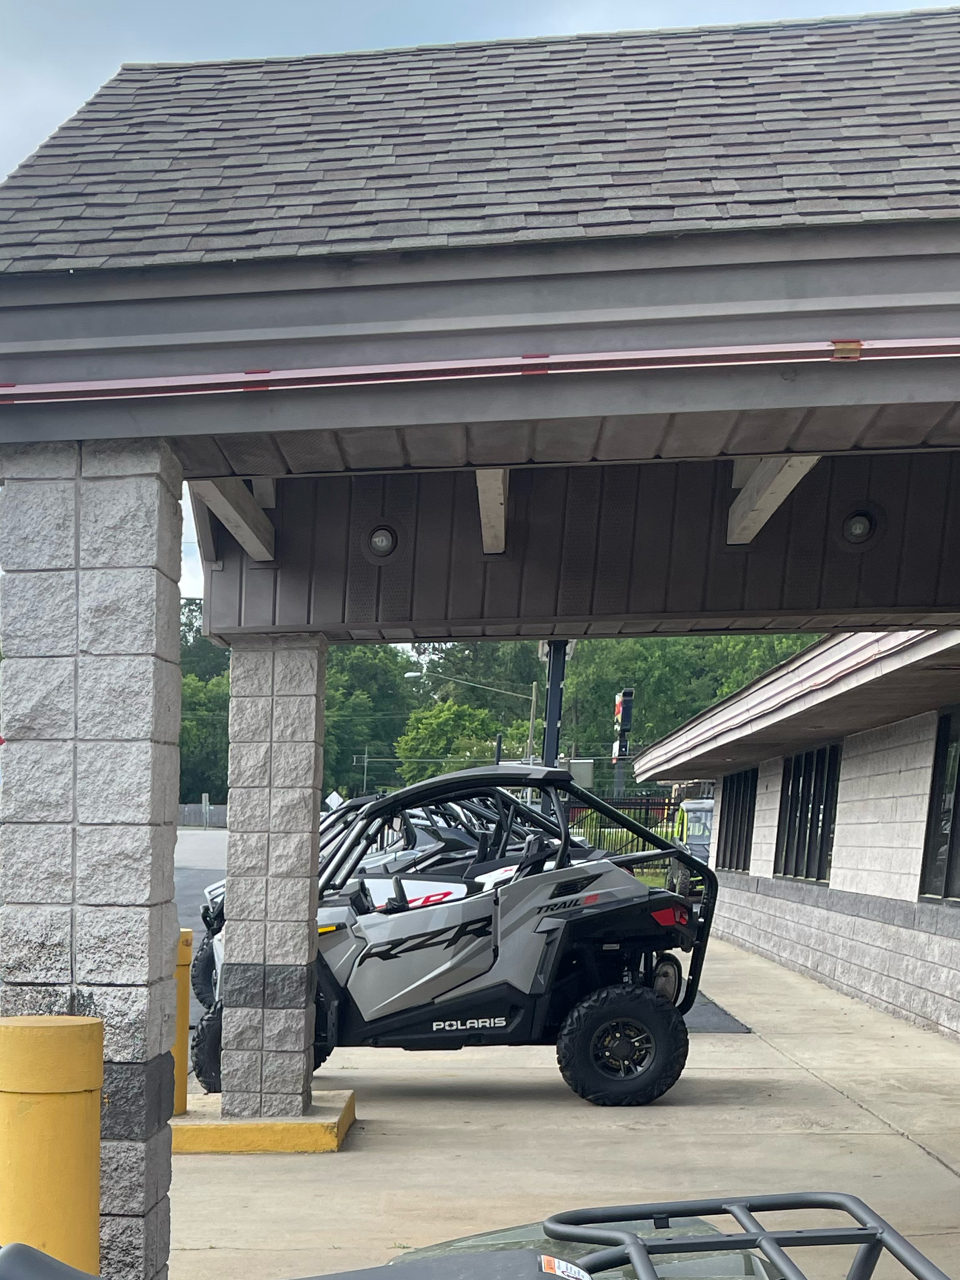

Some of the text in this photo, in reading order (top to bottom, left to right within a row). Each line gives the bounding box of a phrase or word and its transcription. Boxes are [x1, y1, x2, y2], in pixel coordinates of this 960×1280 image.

[536, 898, 582, 915] TRAIL
[357, 914, 493, 967] RZR
[432, 1016, 507, 1031] POLARIS
